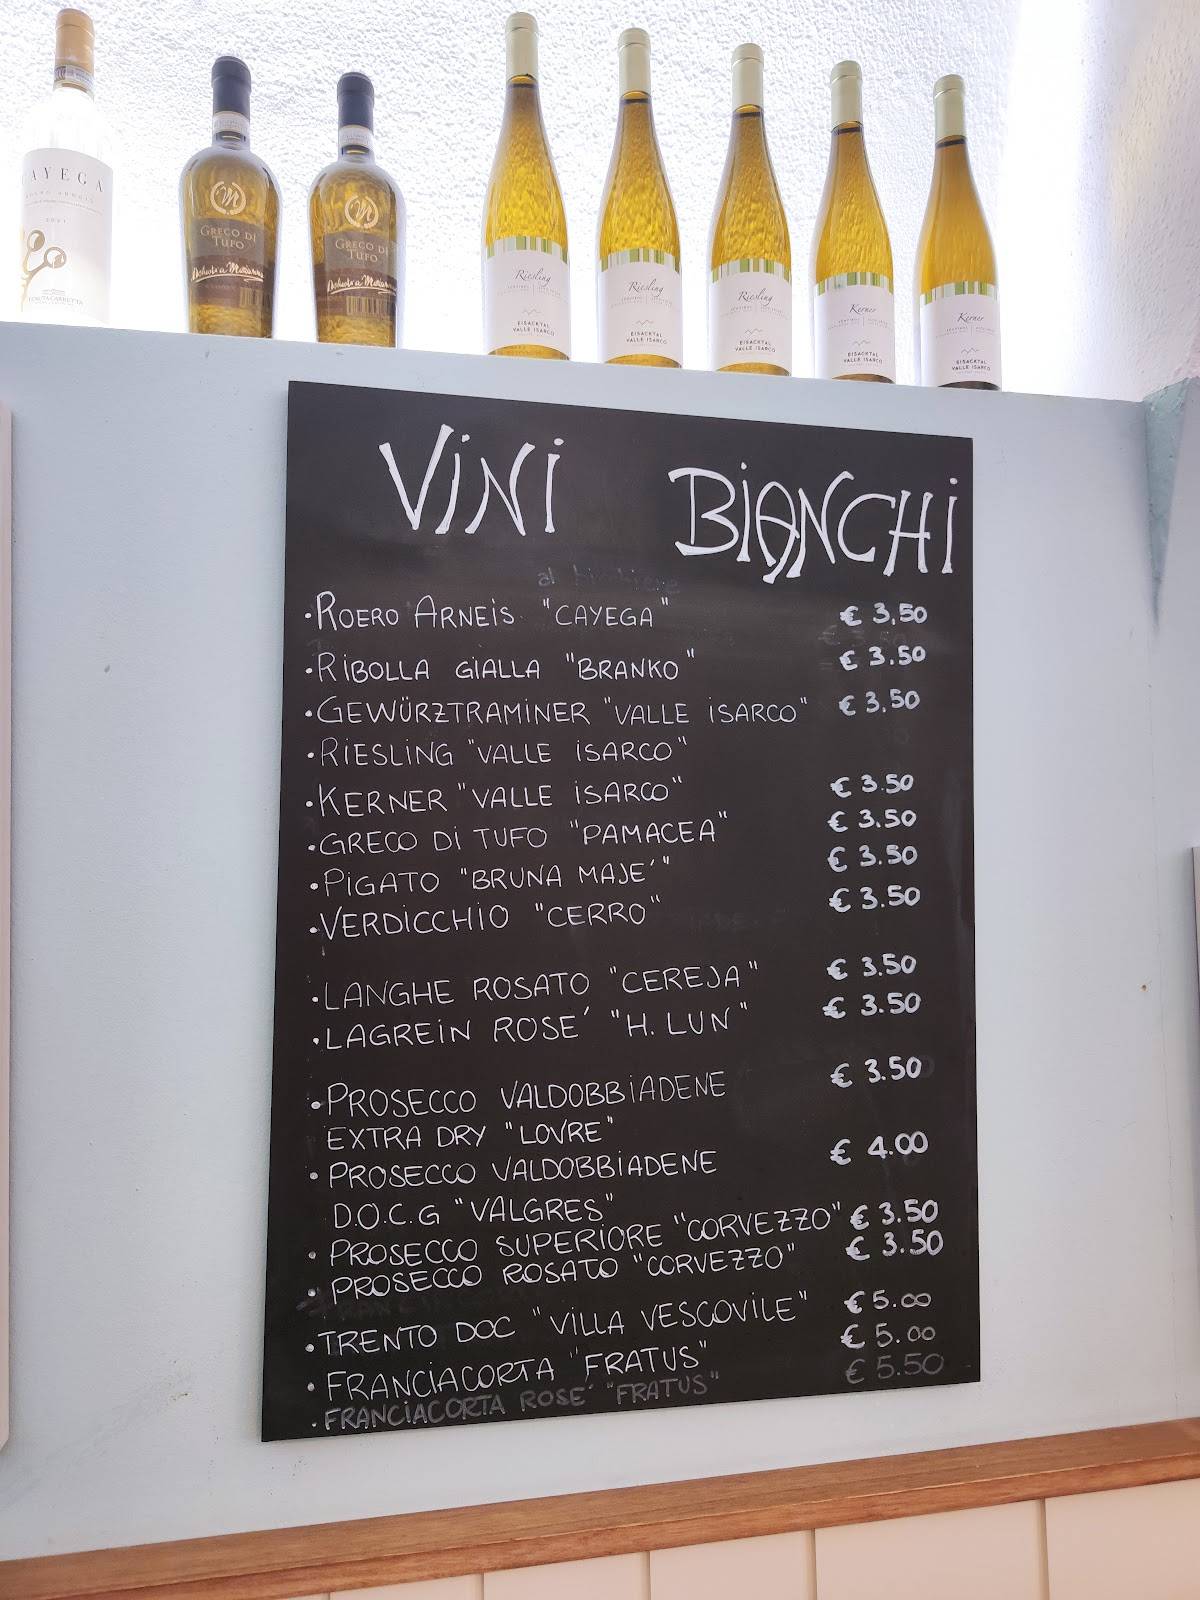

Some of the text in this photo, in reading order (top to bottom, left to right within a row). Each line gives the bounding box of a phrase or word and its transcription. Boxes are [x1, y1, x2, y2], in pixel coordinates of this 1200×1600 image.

[22, 167, 103, 192] AYEGA
[213, 236, 245, 249] TUFO
[349, 250, 378, 263] TUFO
[514, 268, 551, 287] Riesling
[628, 279, 664, 297] Riesling
[737, 288, 773, 306] Riesling
[848, 304, 877, 315] Kerner
[517, 320, 550, 328] EISACKTAL
[957, 312, 984, 322] Kerner
[533, 328, 555, 336] ISARCO
[863, 357, 883, 365] ISARCO
[316, 590, 399, 631] ROERO
[839, 605, 863, 627] €
[838, 649, 859, 671] €
[868, 644, 926, 667] 3.50
[838, 694, 857, 717] €
[318, 783, 448, 817] KERNER
[829, 776, 852, 799] €
[860, 773, 914, 794] 3.50
[319, 830, 418, 856] GRECO
[472, 826, 548, 850] TUFO
[827, 810, 849, 833] €
[858, 808, 917, 829] 3.50
[827, 846, 848, 873] €
[858, 844, 918, 867] 3.50
[828, 888, 852, 913] €
[860, 885, 921, 910] 3.50
[325, 979, 453, 1011] LANGHE
[473, 972, 590, 1001] ROSATO
[826, 958, 849, 981] €
[861, 952, 917, 977] 3.50
[822, 996, 847, 1020] €
[860, 992, 922, 1016] 3.50
[327, 1082, 477, 1118] PROSECCO
[829, 1062, 853, 1089] €
[864, 1056, 922, 1083] 3.50
[327, 1125, 422, 1151] EXTRA
[437, 1124, 487, 1148] DRY
[329, 1161, 476, 1190] PROSECCO
[829, 1138, 852, 1166] €
[867, 1130, 929, 1158] 4.00
[329, 1238, 479, 1268] PROSECCO
[849, 1204, 870, 1231] €
[878, 1198, 939, 1226] 3.50
[331, 1263, 483, 1305] PROSECCO
[500, 1251, 619, 1285] ROSATO
[845, 1235, 871, 1261] €
[882, 1230, 944, 1257] 3.50
[317, 1324, 438, 1356] TRENTO
[455, 1315, 516, 1343] DOC
[843, 1290, 865, 1314] €
[872, 1289, 932, 1310] 5.00
[839, 1323, 866, 1349] €
[875, 1322, 936, 1348] 5.00
[845, 1358, 867, 1384] €
[877, 1350, 945, 1378] 5.50
